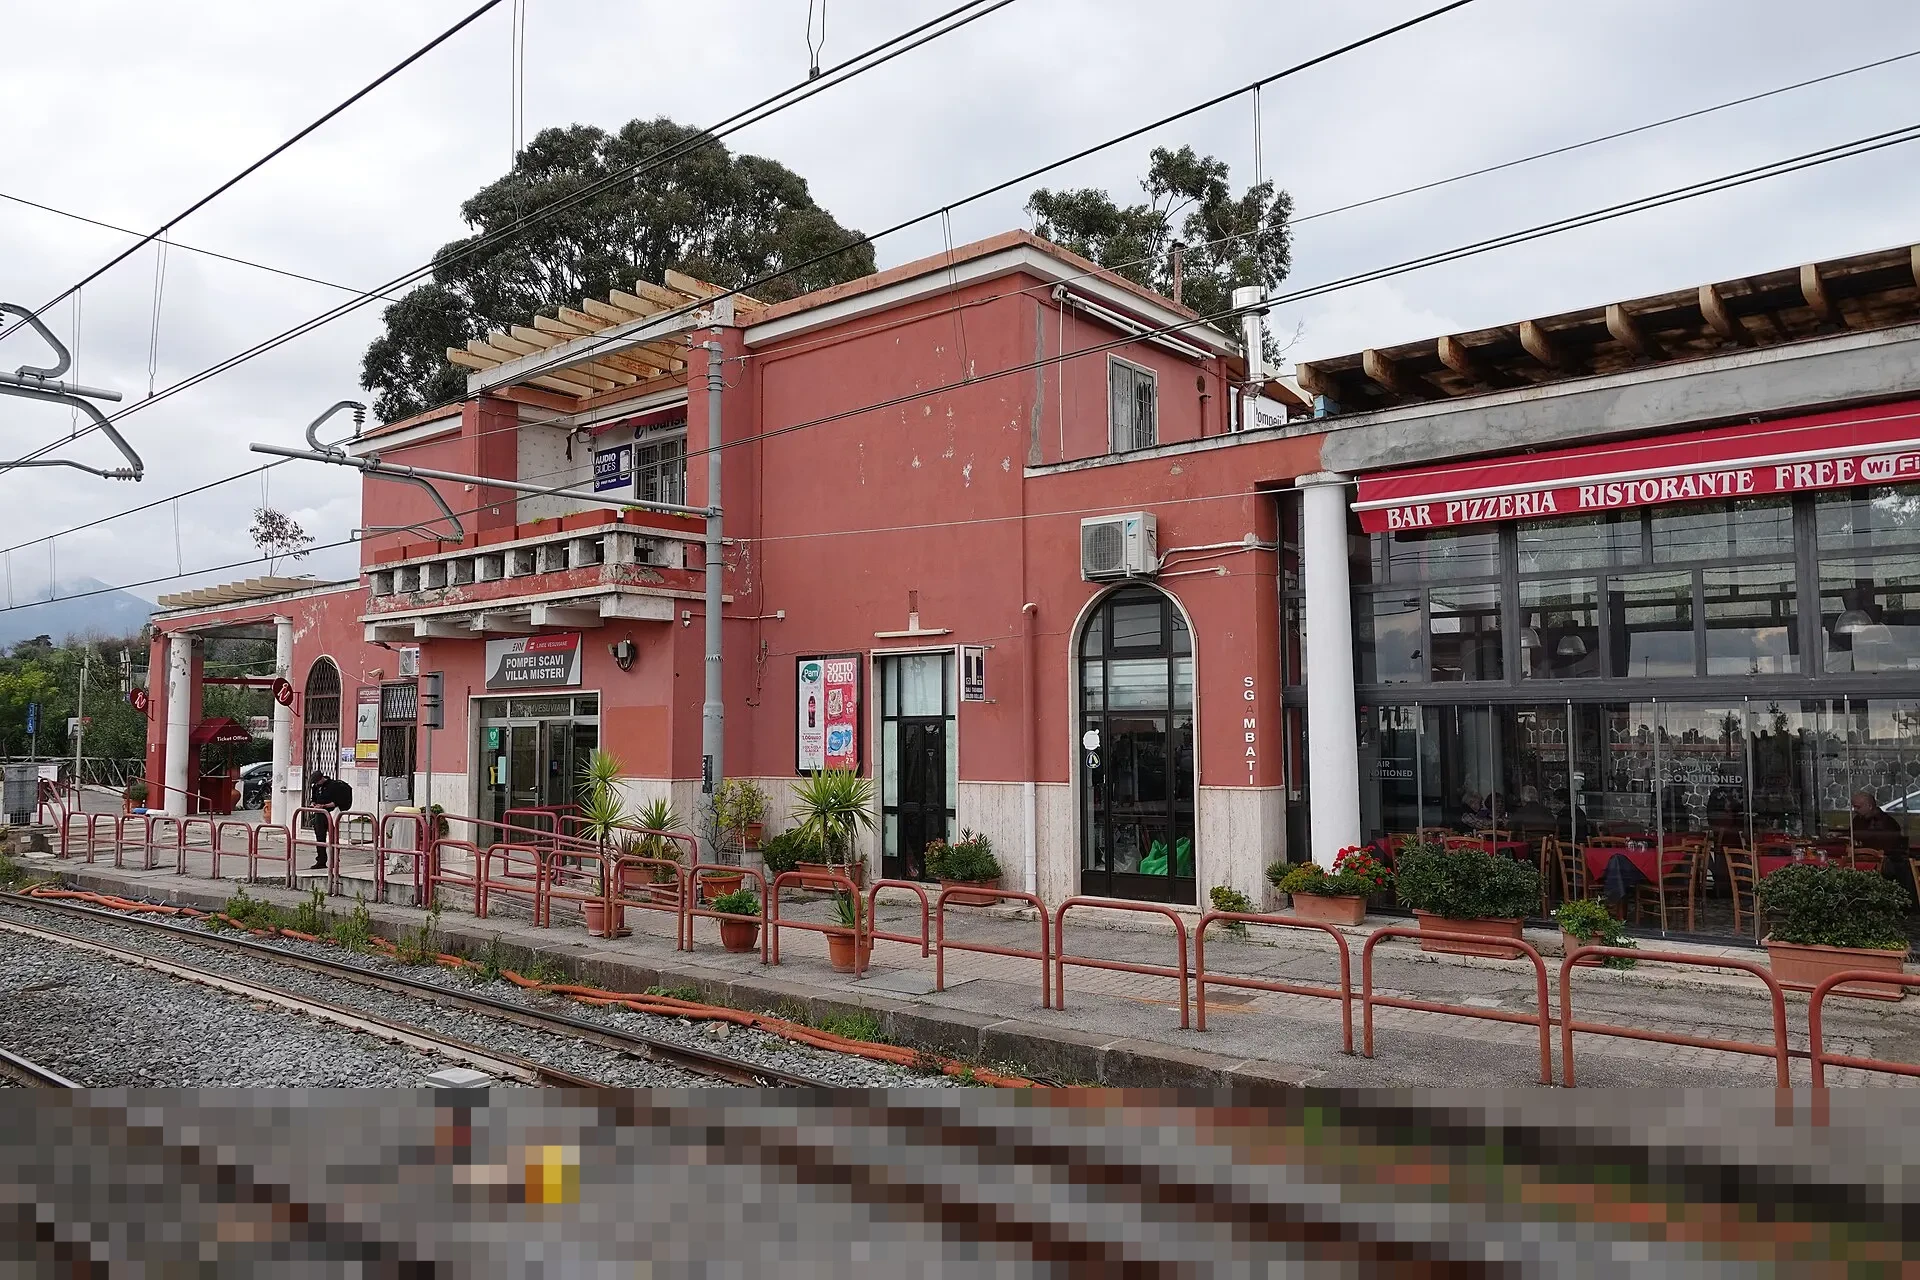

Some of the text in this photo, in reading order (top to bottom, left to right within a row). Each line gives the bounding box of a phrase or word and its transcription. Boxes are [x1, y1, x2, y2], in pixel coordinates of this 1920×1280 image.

[595, 453, 617, 465] AUDIO
[595, 461, 616, 474] GUIDES
[1386, 504, 1433, 529] BAR
[1446, 491, 1558, 523] PIZZERIA
[1578, 469, 1755, 508] RISTORANTE
[1774, 459, 1857, 490] FREE
[506, 654, 564, 668] POMPEI SCAVI
[827, 661, 853, 673] SOTTO
[505, 667, 565, 681] VILLA MISTERI
[803, 668, 819, 677] Pam
[827, 671, 853, 683] COSTO
[1376, 760, 1391, 768] AIR
[1666, 774, 1743, 784] CONDITIONED
